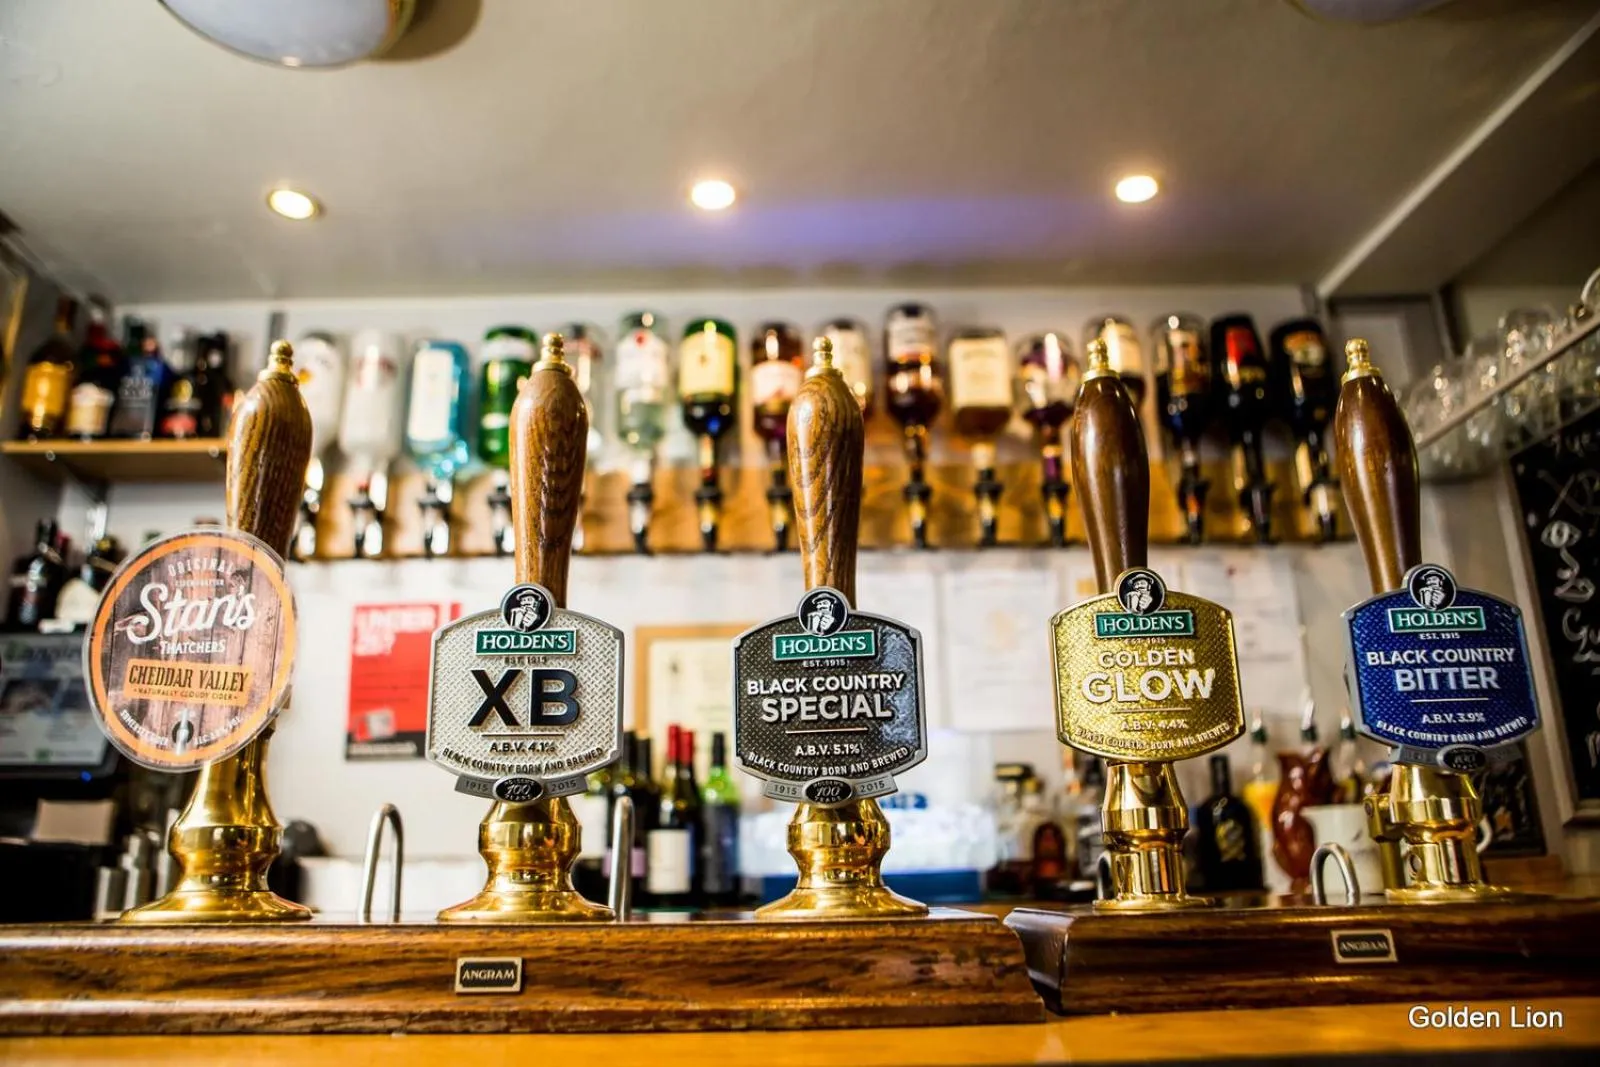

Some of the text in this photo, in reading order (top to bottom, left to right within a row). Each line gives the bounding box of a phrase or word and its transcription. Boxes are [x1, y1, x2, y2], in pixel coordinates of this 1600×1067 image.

[126, 582, 256, 644] Stan's
[1397, 611, 1478, 627] HOLDEN'S
[1103, 616, 1185, 632] HOLDEN'S
[159, 640, 227, 656] THATCHERS
[482, 633, 568, 650] HOLDEN'S
[781, 636, 867, 655] HOLDEN'S
[1098, 650, 1195, 667] GOLDEN
[1366, 647, 1516, 666] BLACK COUNTRY
[128, 664, 249, 692] CHEDDAR VALLEY
[747, 673, 905, 696] BLACK COUNTRY
[1081, 668, 1216, 704] GLOW
[1394, 666, 1501, 692] BITTER
[468, 668, 580, 727] XB
[761, 693, 893, 723] SPECIAL
[1421, 712, 1486, 724] A.B.V. 3.9%
[1376, 716, 1529, 743] BLACK COUNTRY BORN AND BREWED
[489, 741, 556, 753] A.B.V. 4.1%
[795, 743, 860, 757] A.B.V. 5.1%
[442, 747, 604, 774] BLACK COUNTRY BORN AND BREWED
[748, 746, 909, 776] BLACK COUNTRY BORN AND BREWED
[464, 780, 489, 791] 1915
[505, 784, 531, 795] 100
[551, 780, 577, 792] 2015
[774, 784, 797, 795] 1915
[816, 786, 840, 797] 100
[860, 781, 885, 793] 2015
[462, 969, 515, 980] ANGRAM
